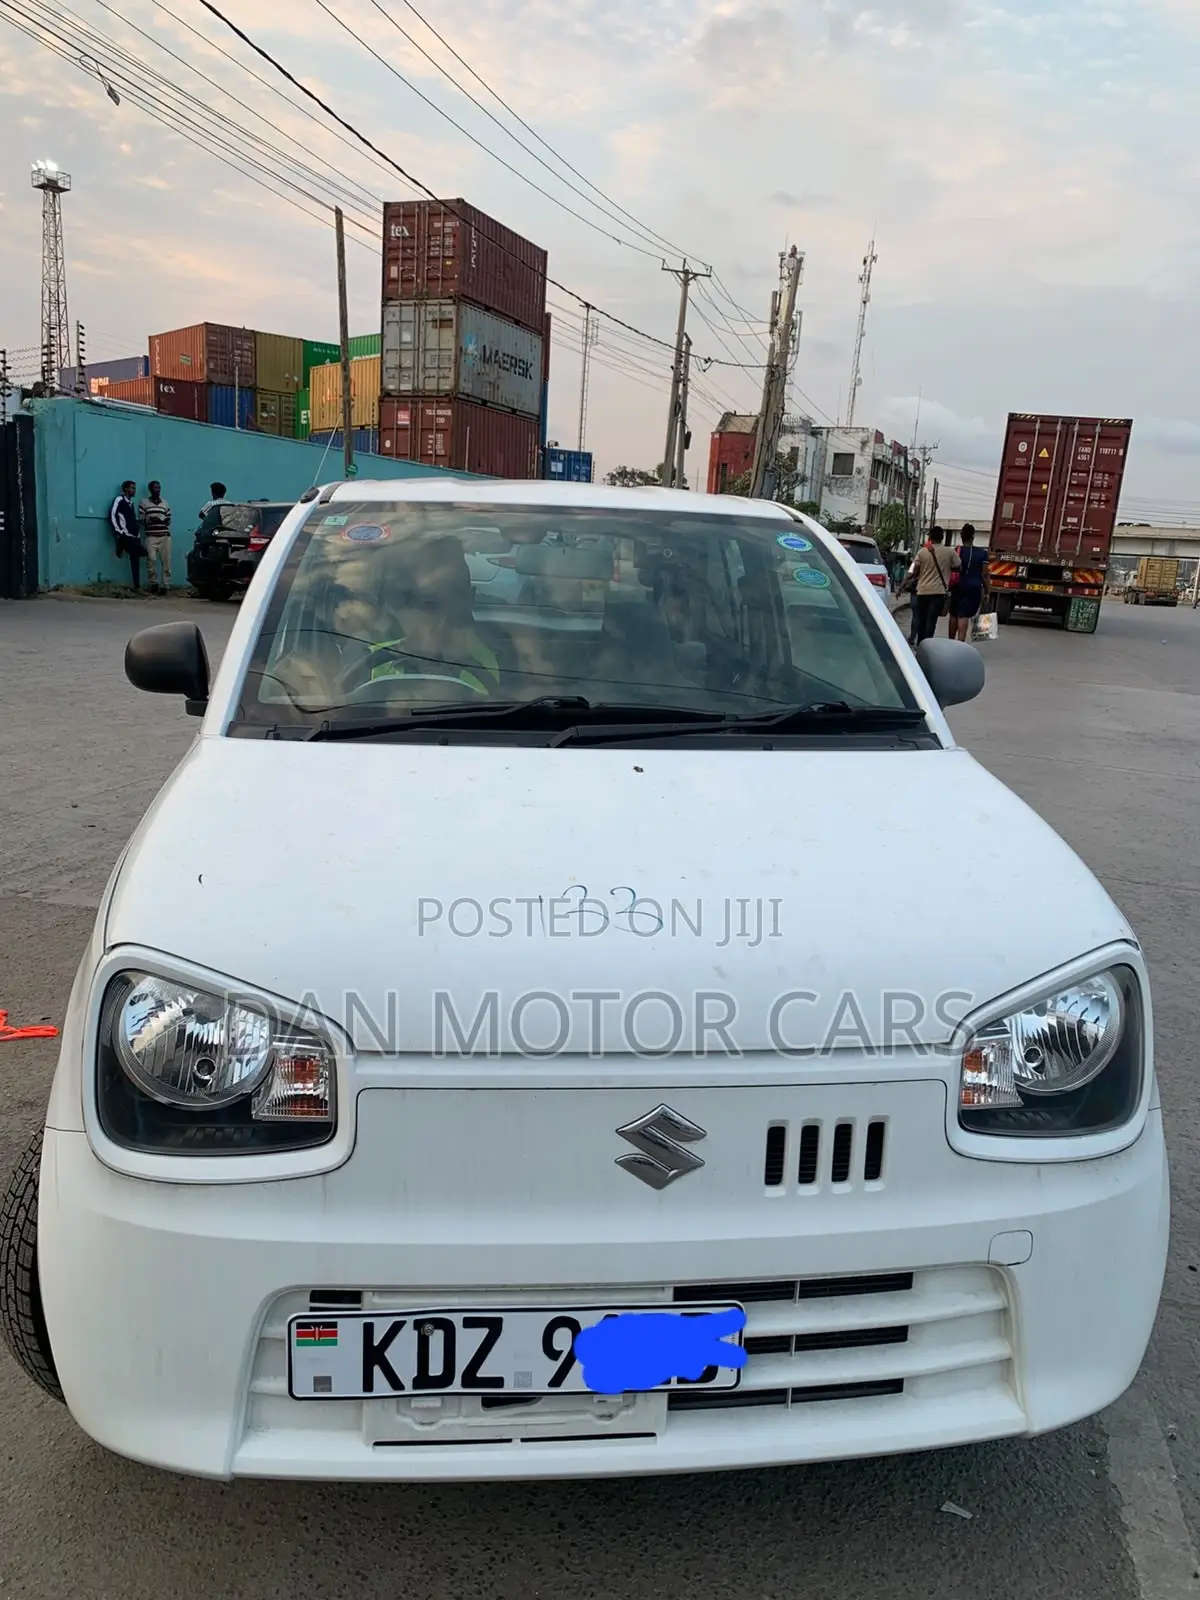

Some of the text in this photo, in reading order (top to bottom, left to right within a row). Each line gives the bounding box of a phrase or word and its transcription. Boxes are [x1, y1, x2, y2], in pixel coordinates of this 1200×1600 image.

[390, 223, 410, 237] tex
[482, 343, 533, 381] MAERSK
[160, 383, 176, 394] tex
[362, 1315, 505, 1393] KDZ
